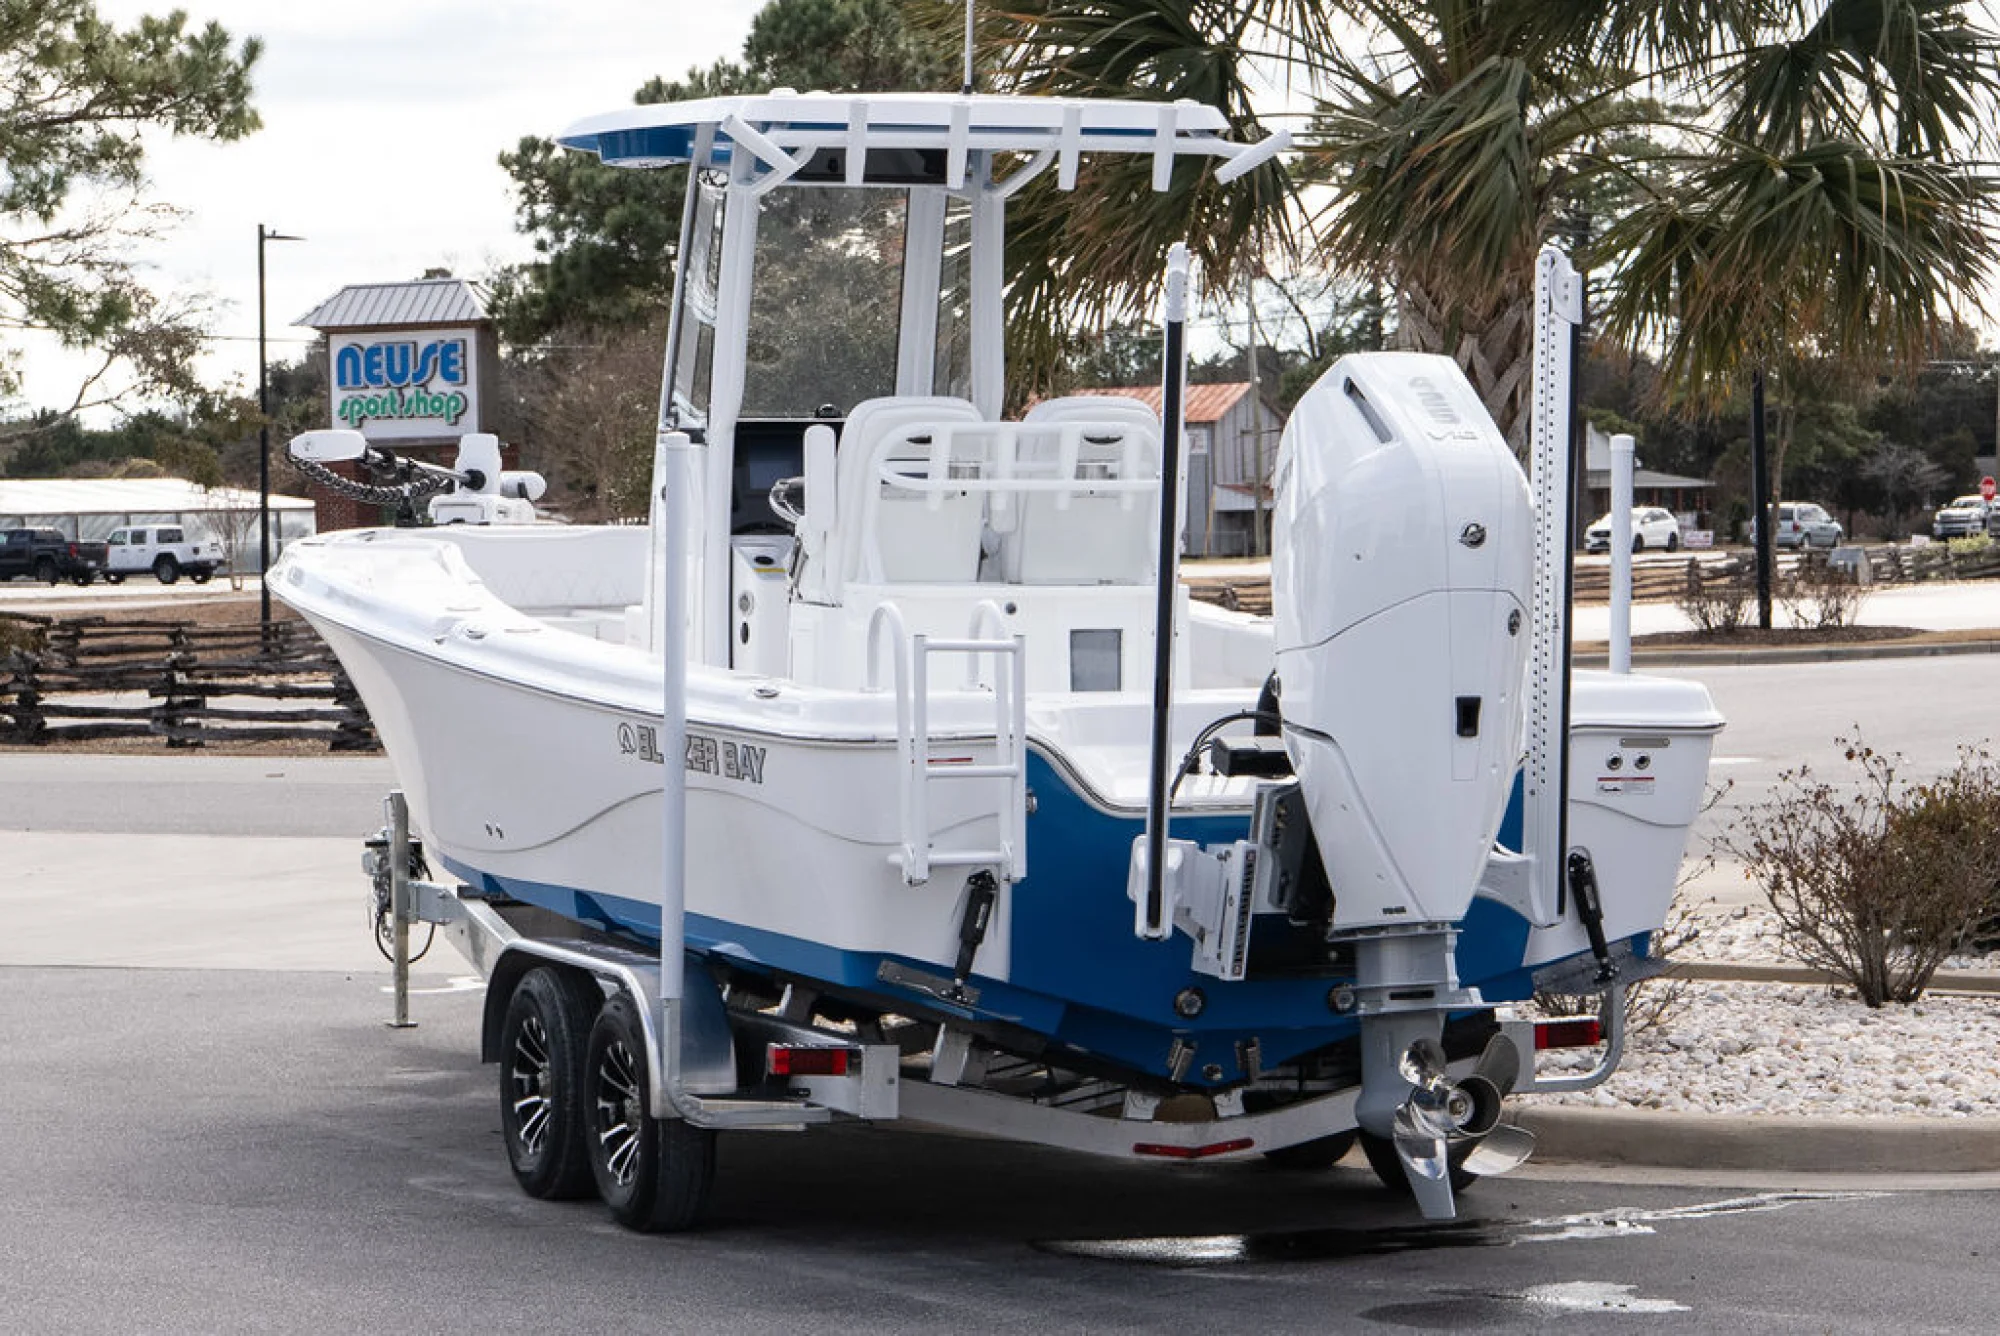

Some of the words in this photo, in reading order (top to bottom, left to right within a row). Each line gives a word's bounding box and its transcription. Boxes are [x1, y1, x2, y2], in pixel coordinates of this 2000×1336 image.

[338, 389, 398, 428] sport
[403, 389, 462, 425] shop
[637, 724, 719, 776] BLZER
[722, 740, 766, 784] BAY
